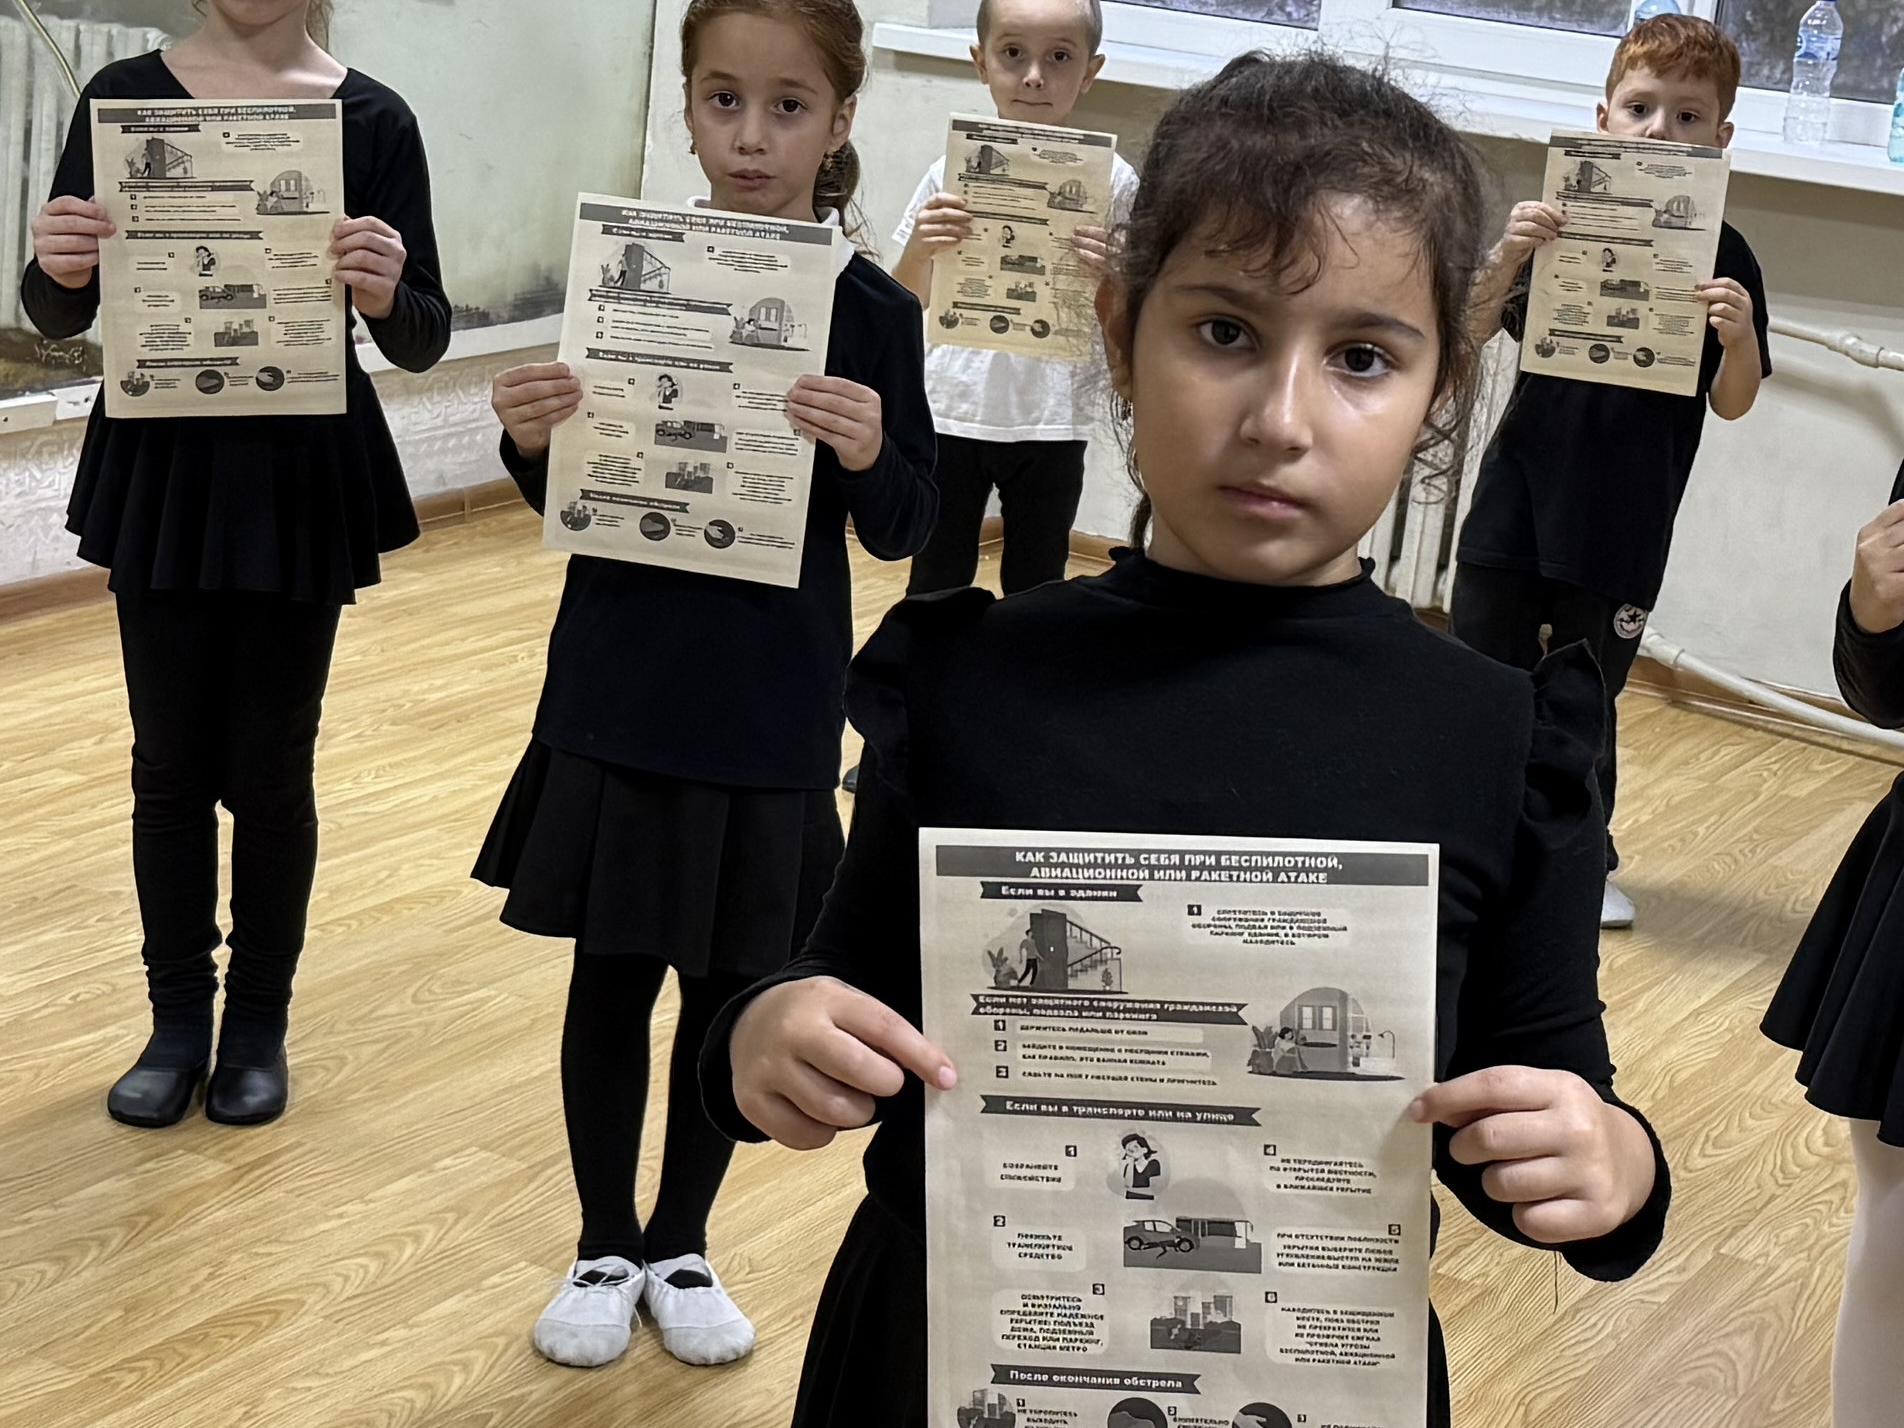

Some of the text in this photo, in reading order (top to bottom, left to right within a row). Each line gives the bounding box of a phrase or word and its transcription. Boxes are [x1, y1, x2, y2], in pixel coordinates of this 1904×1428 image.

[1016, 852, 1342, 870] КАК ЗАЩИТИТЬ СЕБЯ ПРИ БЕСПИЛОТНОЙ,
[1030, 867, 1327, 883] АВИАЦИОННОЙ ИЛИ РАКЕТНОЙ АТАКЕ
[1002, 886, 1033, 895] Если
[1006, 1100, 1036, 1111] Если
[1149, 1109, 1172, 1118] или
[1010, 1370, 1182, 1389] После окончания обстрела
